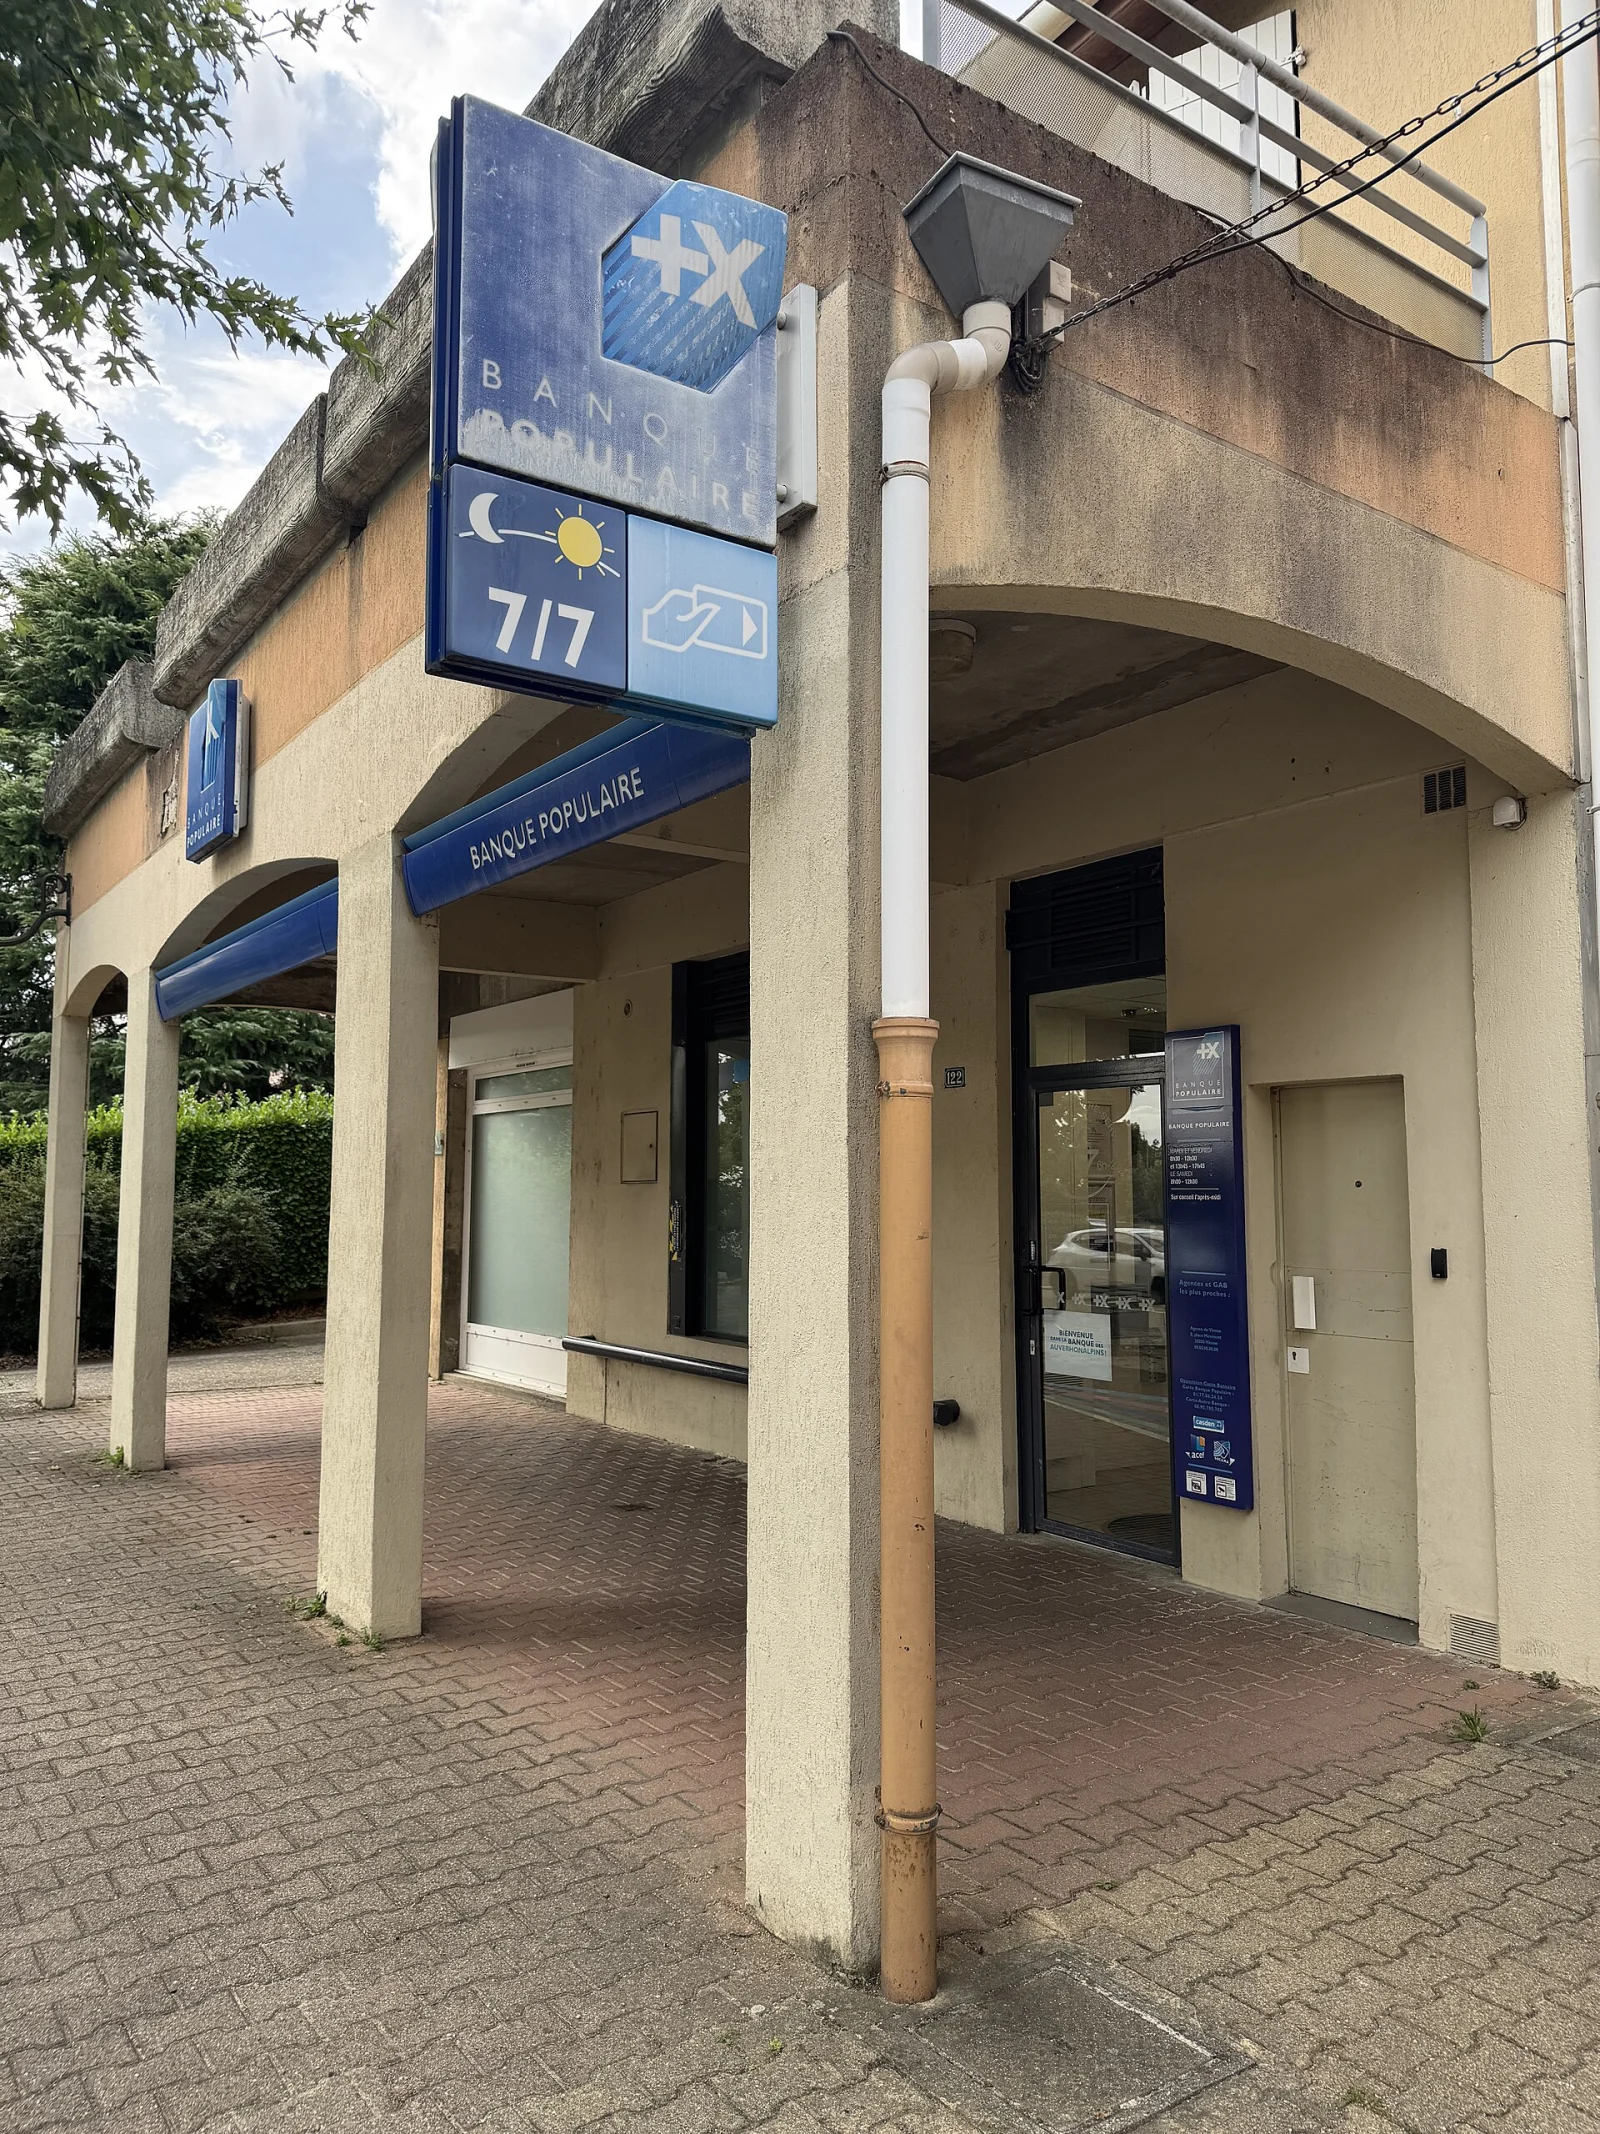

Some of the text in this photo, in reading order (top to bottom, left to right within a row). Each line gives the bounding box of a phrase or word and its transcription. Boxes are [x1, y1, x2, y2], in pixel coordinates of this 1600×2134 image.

[482, 359, 760, 474] BANQUE
[479, 408, 759, 520] POPULAIRE
[488, 586, 596, 669] 7/7
[187, 792, 222, 829] BANQUE
[470, 766, 645, 870] BANQUE POPULAIRE
[186, 813, 222, 849] POPULAIRE
[946, 1071, 962, 1085] 122
[1175, 1080, 1221, 1089] BANQUE
[1175, 1088, 1221, 1097] POPULAIRE
[1168, 1121, 1230, 1130] BANQUE POPULAIRE
[1179, 1279, 1204, 1287] Agences
[1212, 1281, 1228, 1289] GAB
[1189, 1288, 1202, 1297] plus
[1202, 1290, 1227, 1298] proches
[1059, 1329, 1094, 1340] BIENVENUE
[1067, 1339, 1095, 1348] BANQUE
[1195, 1419, 1216, 1428] casden
[1191, 1451, 1206, 1459] acef
